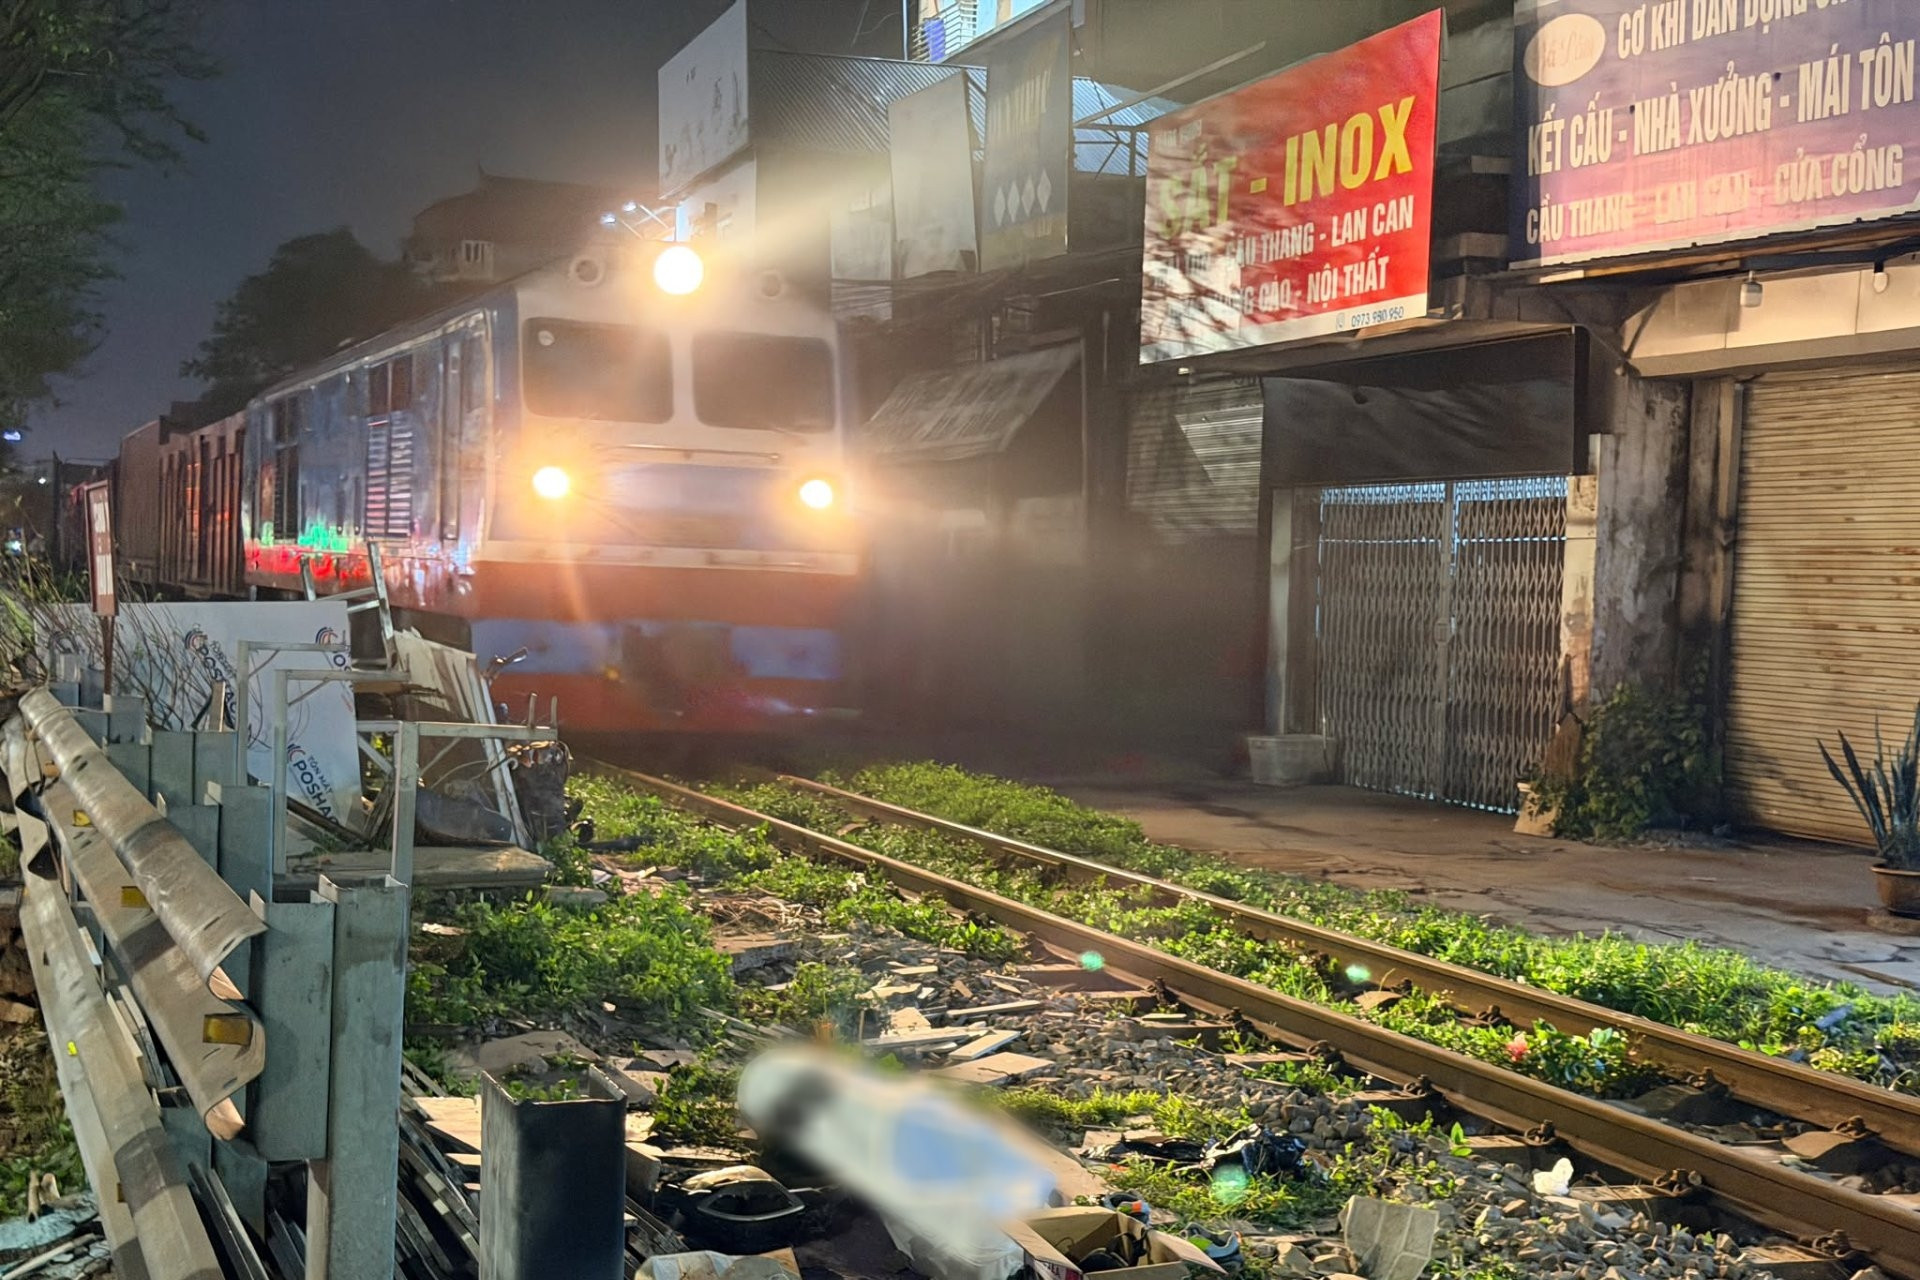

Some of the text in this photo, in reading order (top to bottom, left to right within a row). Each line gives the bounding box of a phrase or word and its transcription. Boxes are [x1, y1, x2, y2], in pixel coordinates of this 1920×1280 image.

[1618, 4, 1647, 59] CƠ
[1528, 103, 1566, 176] KẾT
[1569, 91, 1613, 169] CẤU
[1633, 81, 1682, 156] NHÀ
[1686, 60, 1772, 146] XƯỞNG
[1798, 42, 1851, 123] MÁI
[1859, 31, 1915, 110] TÔN
[1284, 95, 1416, 207] INOX
[1526, 194, 1566, 245] CẦU
[1830, 133, 1905, 198] CỔNG
[1261, 222, 1316, 264] THANG
[1331, 207, 1368, 248] LAN
[1372, 194, 1415, 237] CAN
[1307, 262, 1339, 309] NỘI
[1343, 246, 1390, 297] THẤT
